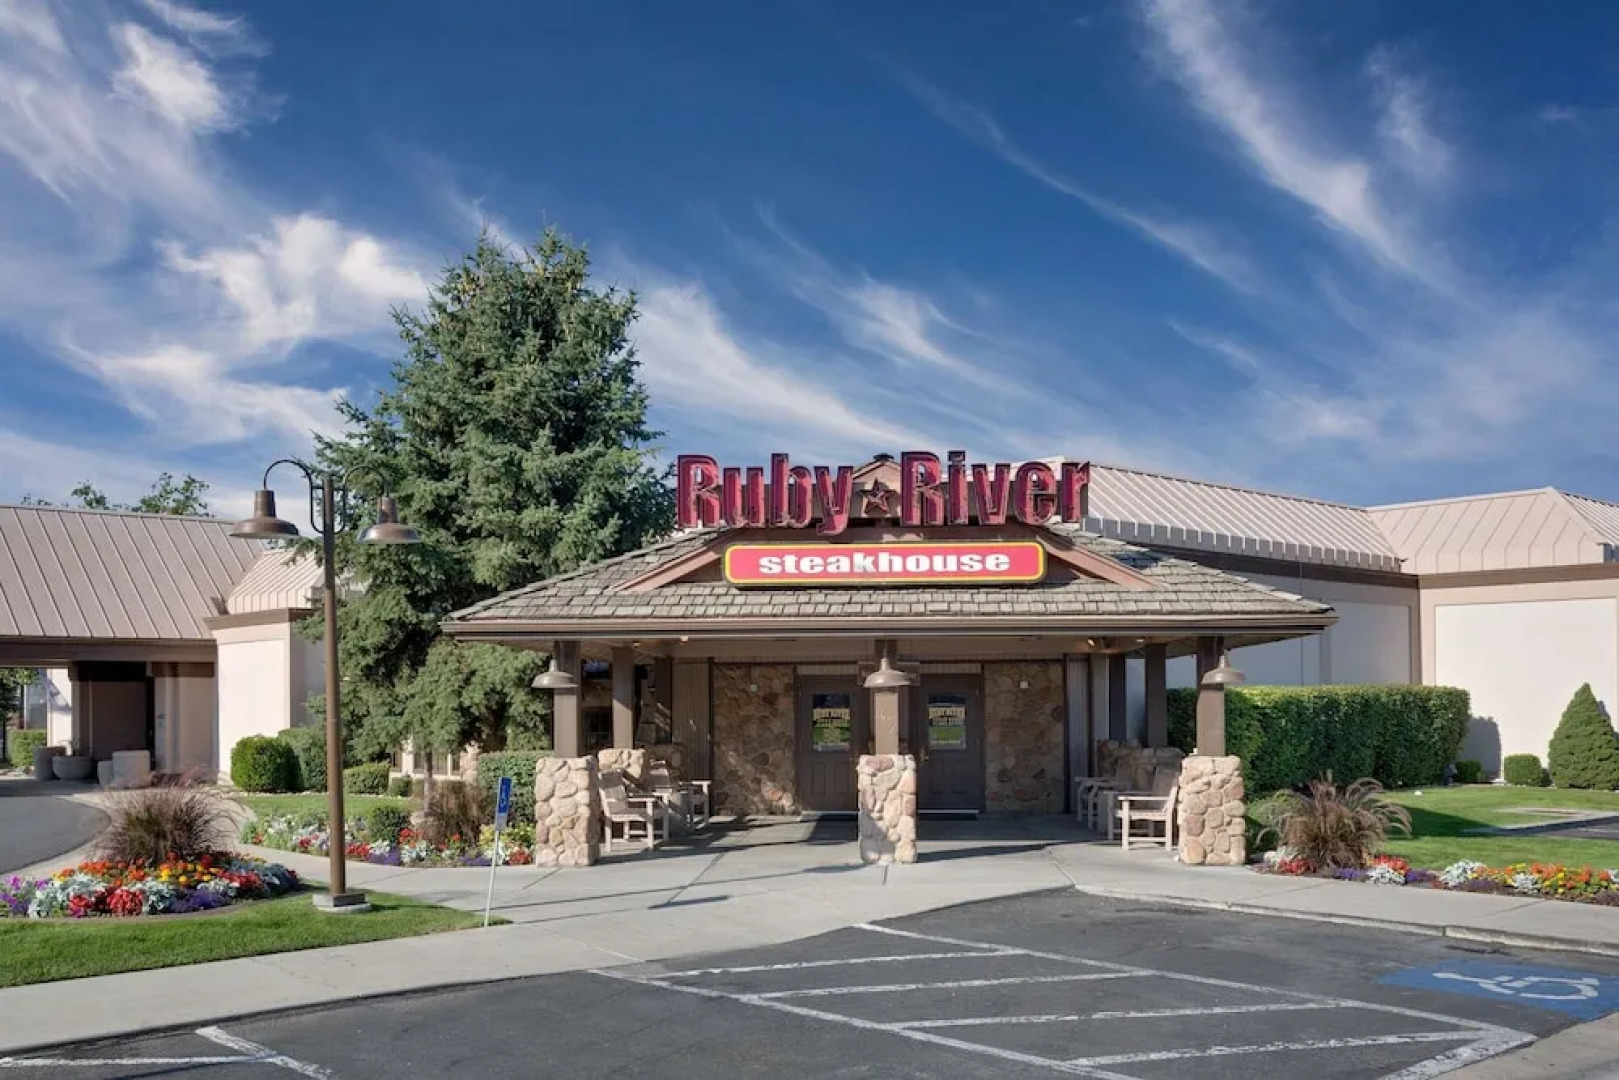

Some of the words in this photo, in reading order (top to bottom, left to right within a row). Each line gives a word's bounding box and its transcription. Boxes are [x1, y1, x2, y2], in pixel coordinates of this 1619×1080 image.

[676, 453, 854, 536] Ruby
[900, 450, 1090, 526] River
[758, 552, 1011, 575] steakhouse
